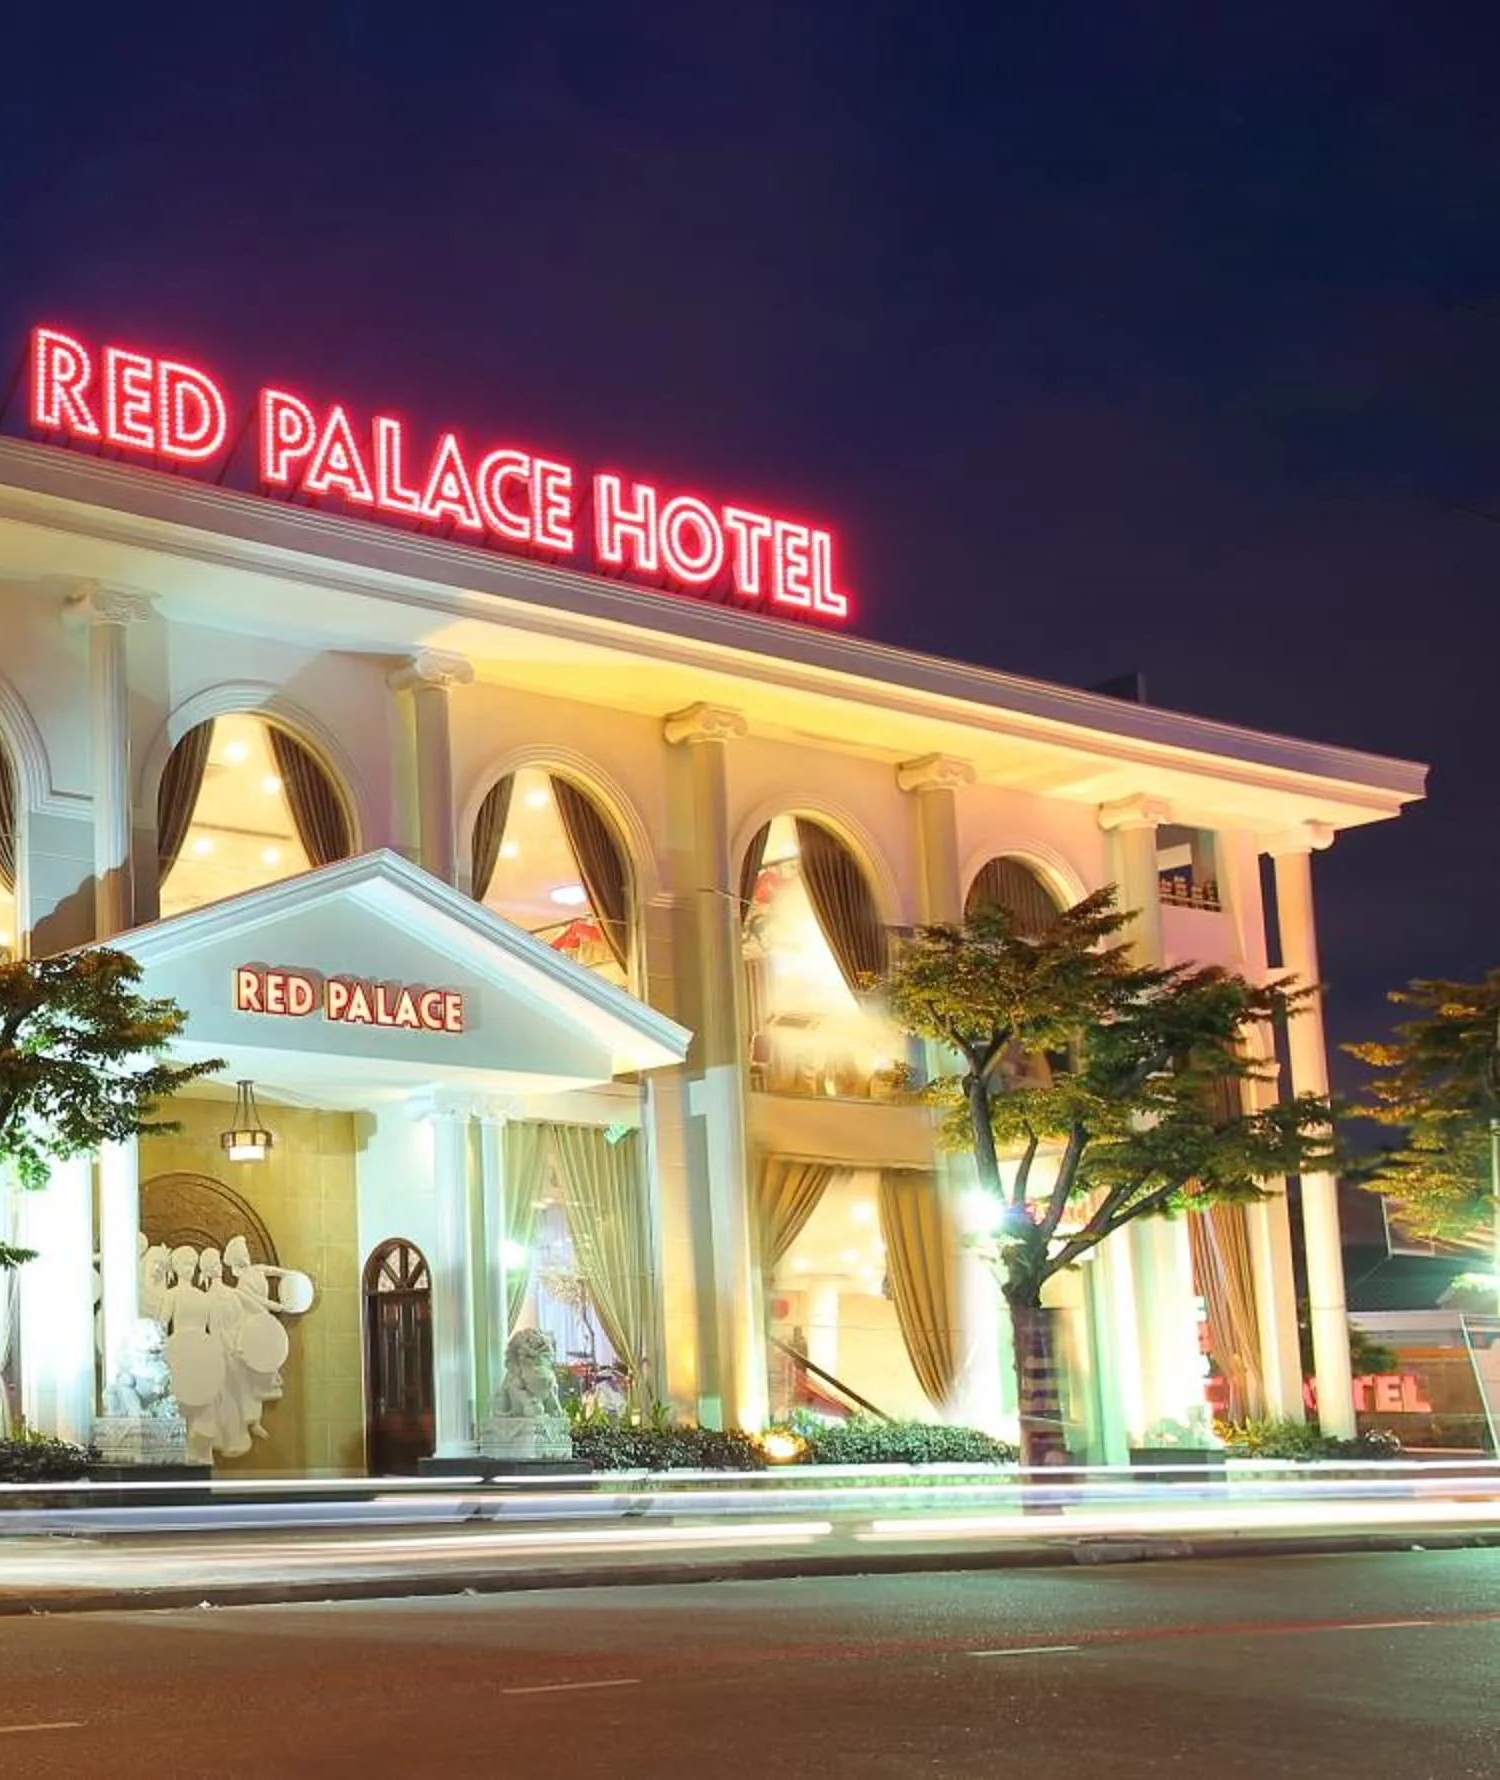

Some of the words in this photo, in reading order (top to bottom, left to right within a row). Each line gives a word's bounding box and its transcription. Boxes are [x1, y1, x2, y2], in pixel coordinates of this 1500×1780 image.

[35, 328, 226, 460] RED
[259, 388, 574, 552] PALACE
[594, 474, 847, 616] HOTEL
[235, 966, 314, 1017] RED
[325, 977, 464, 1034] PALACE
[1303, 1374, 1432, 1413] TEL
